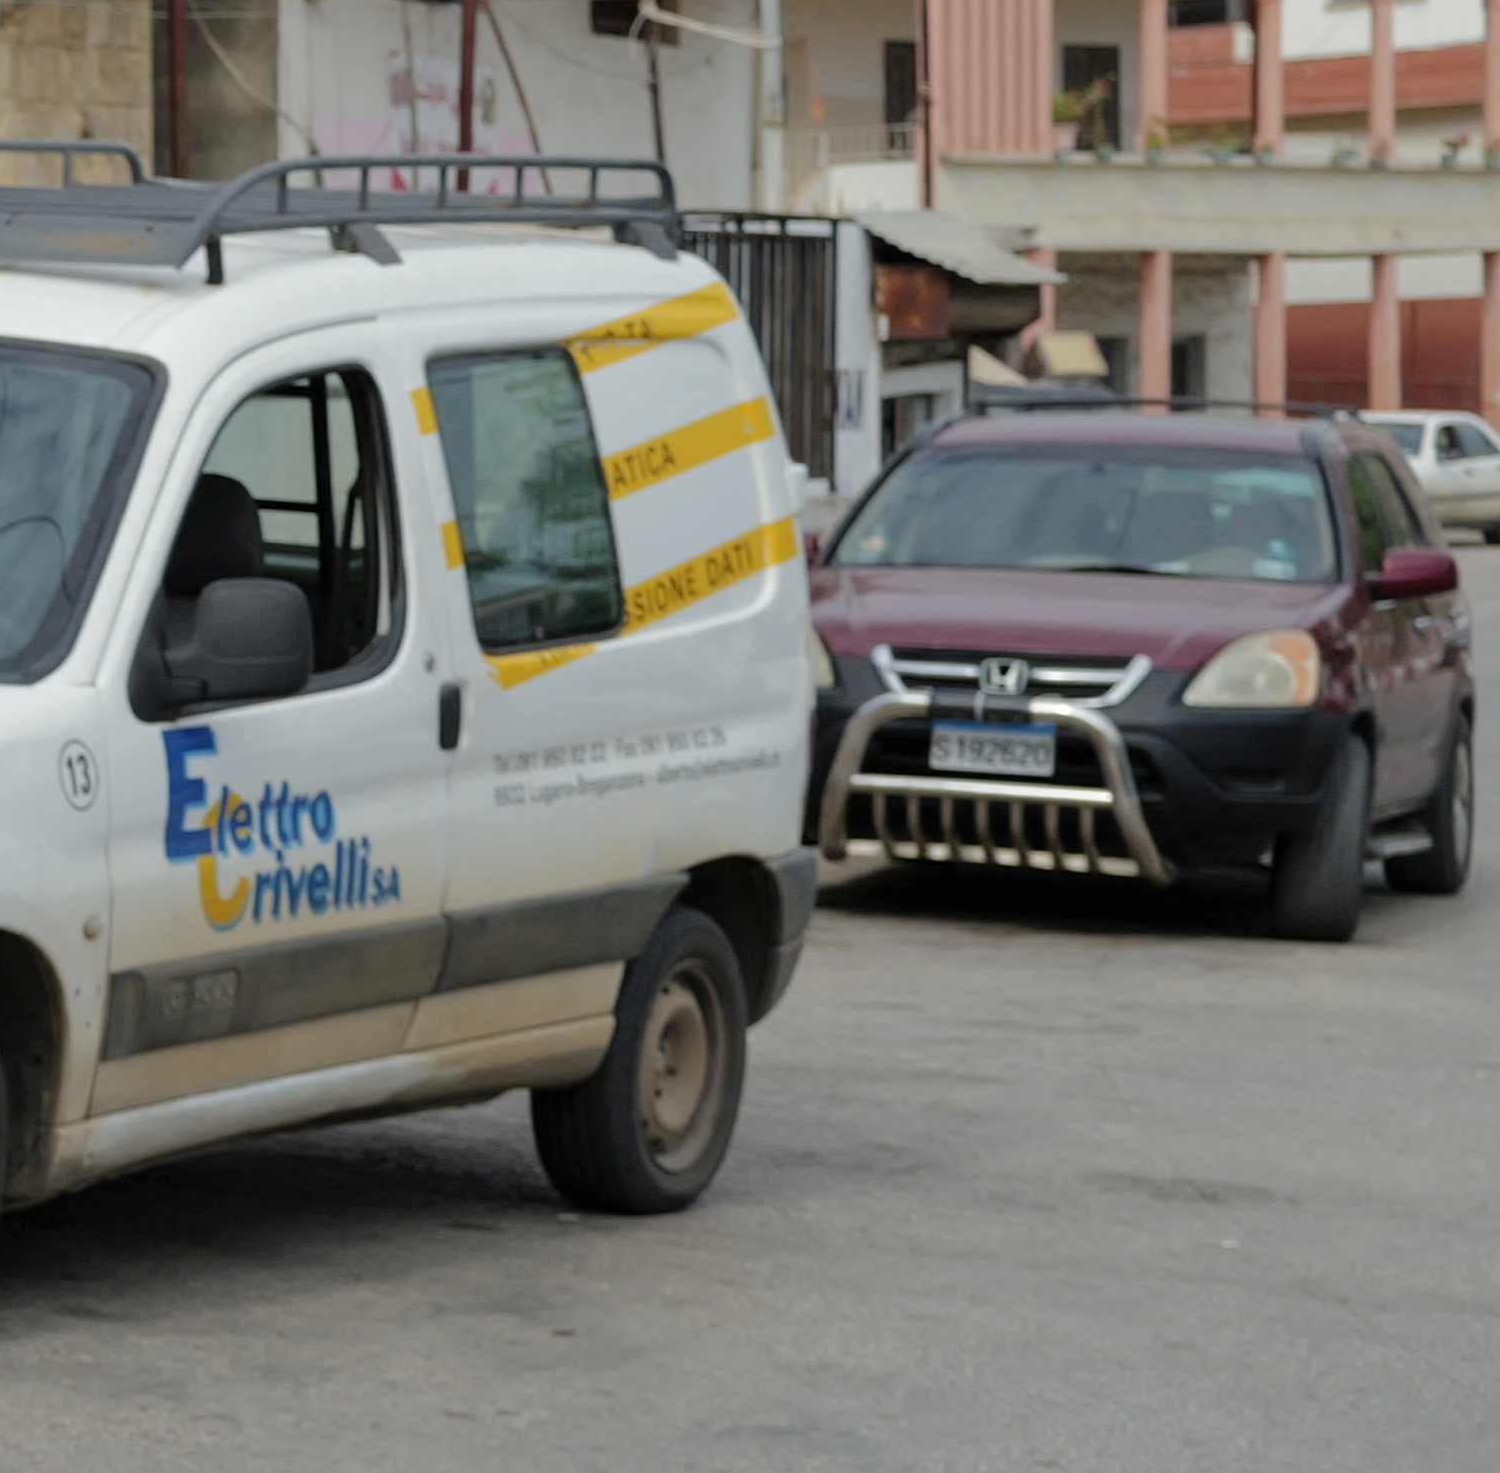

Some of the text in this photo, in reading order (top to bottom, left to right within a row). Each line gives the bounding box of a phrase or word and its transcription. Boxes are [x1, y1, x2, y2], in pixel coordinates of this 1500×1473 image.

[705, 538, 756, 589] DATI
[65, 752, 92, 796] 13
[161, 724, 336, 864] Elettro
[196, 797, 373, 933] Crivelli
